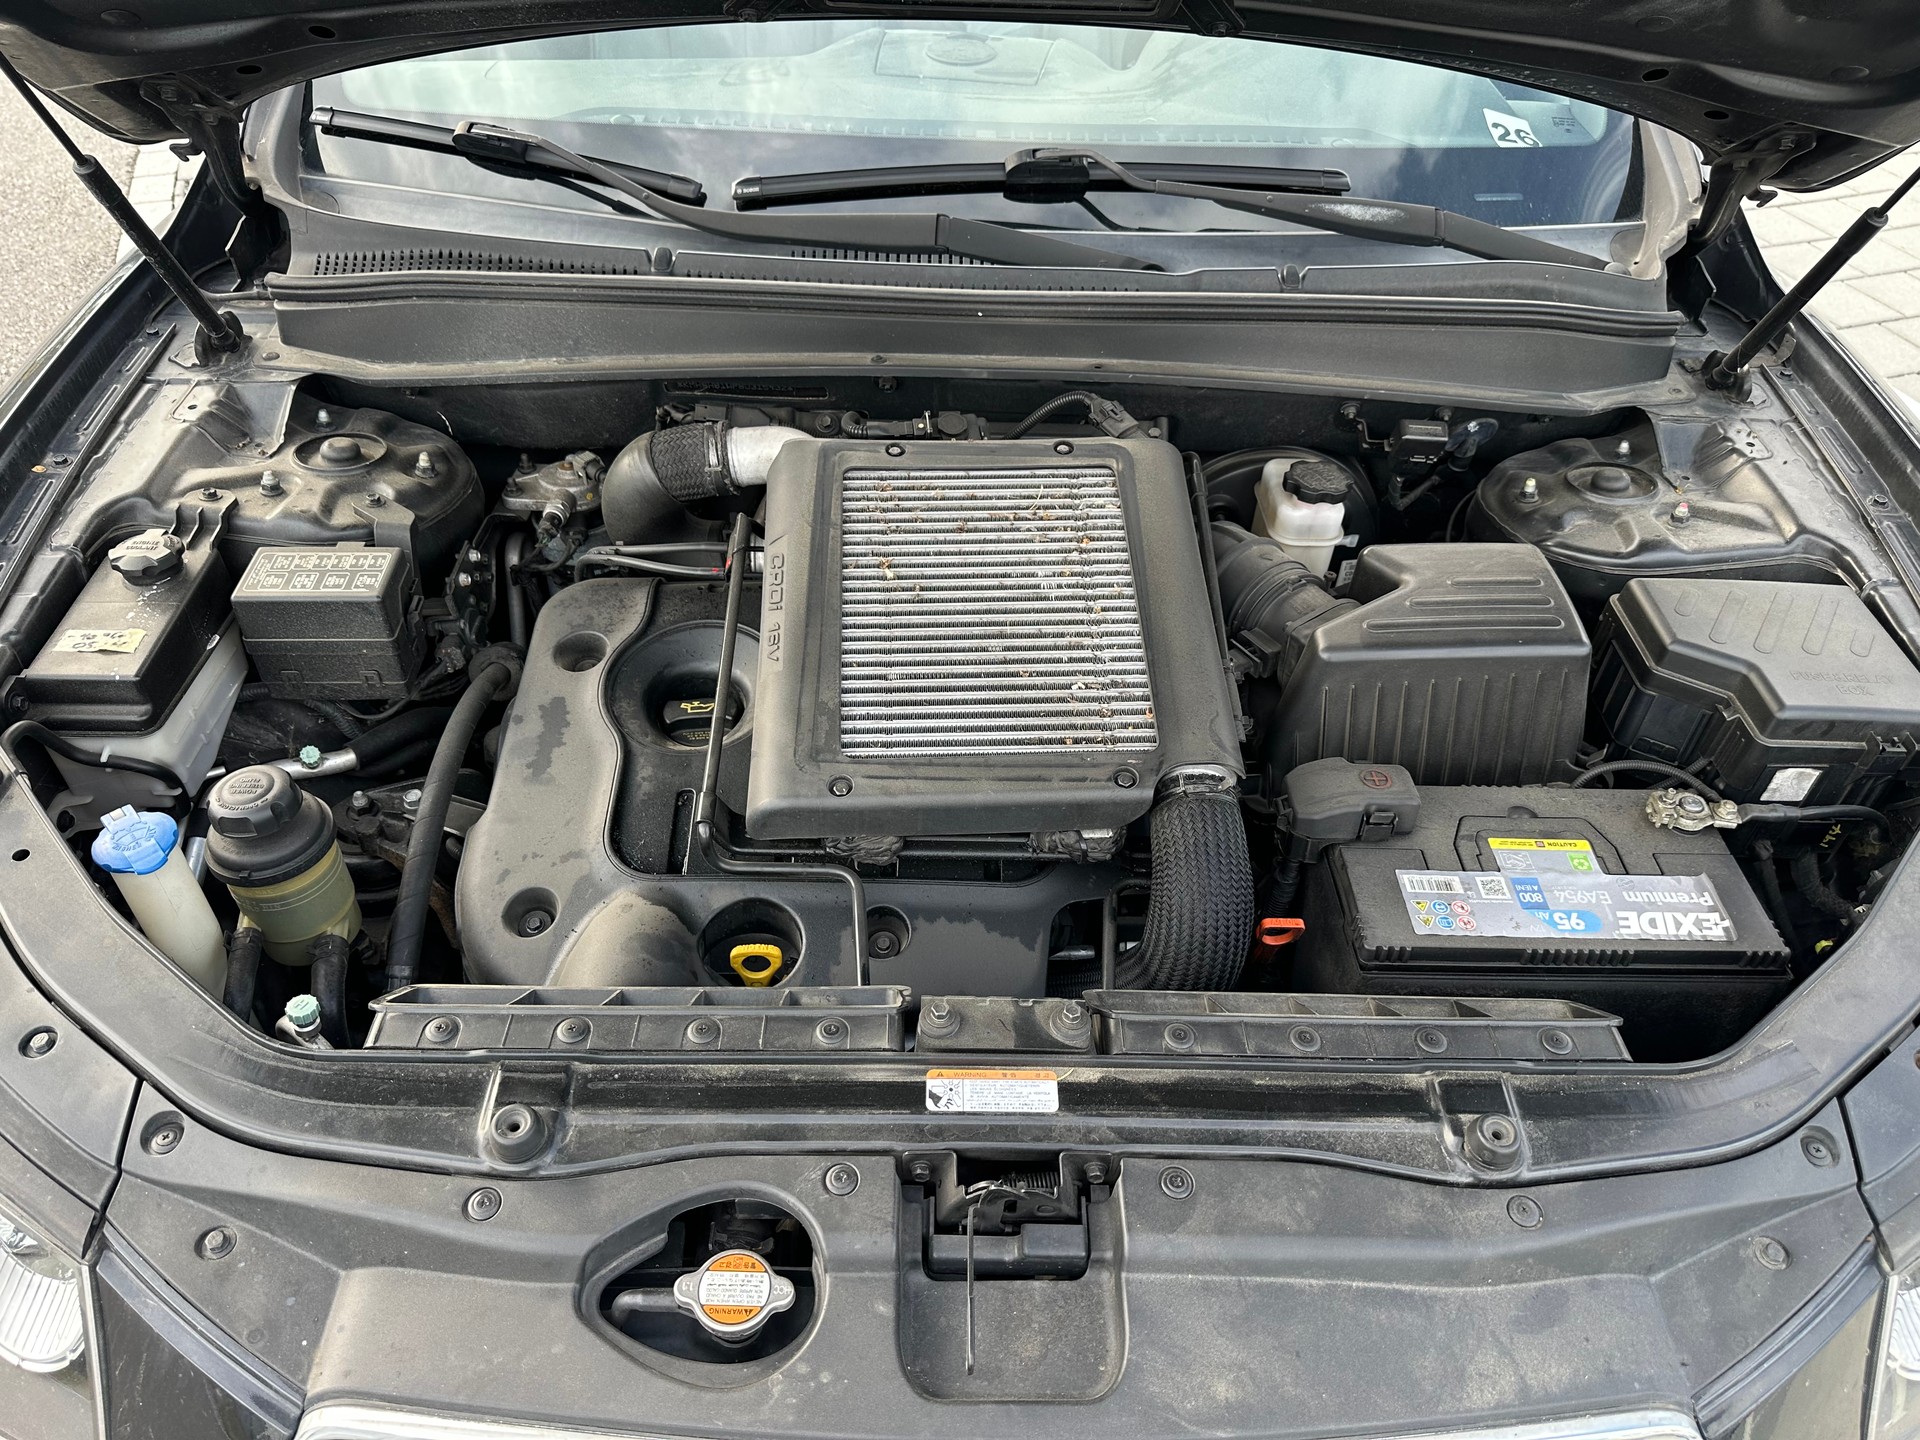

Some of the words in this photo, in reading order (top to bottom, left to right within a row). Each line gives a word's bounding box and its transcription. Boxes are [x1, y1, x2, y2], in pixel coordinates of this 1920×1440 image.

[1491, 122, 1539, 147] 26
[1519, 892, 1543, 903] 800
[1553, 889, 1611, 905] EA954
[1622, 891, 1714, 905] Premium
[1535, 911, 1549, 920] Ah
[1553, 912, 1586, 930] 95
[1616, 911, 1729, 937] EXIDE
[709, 1307, 744, 1315] WARNING
